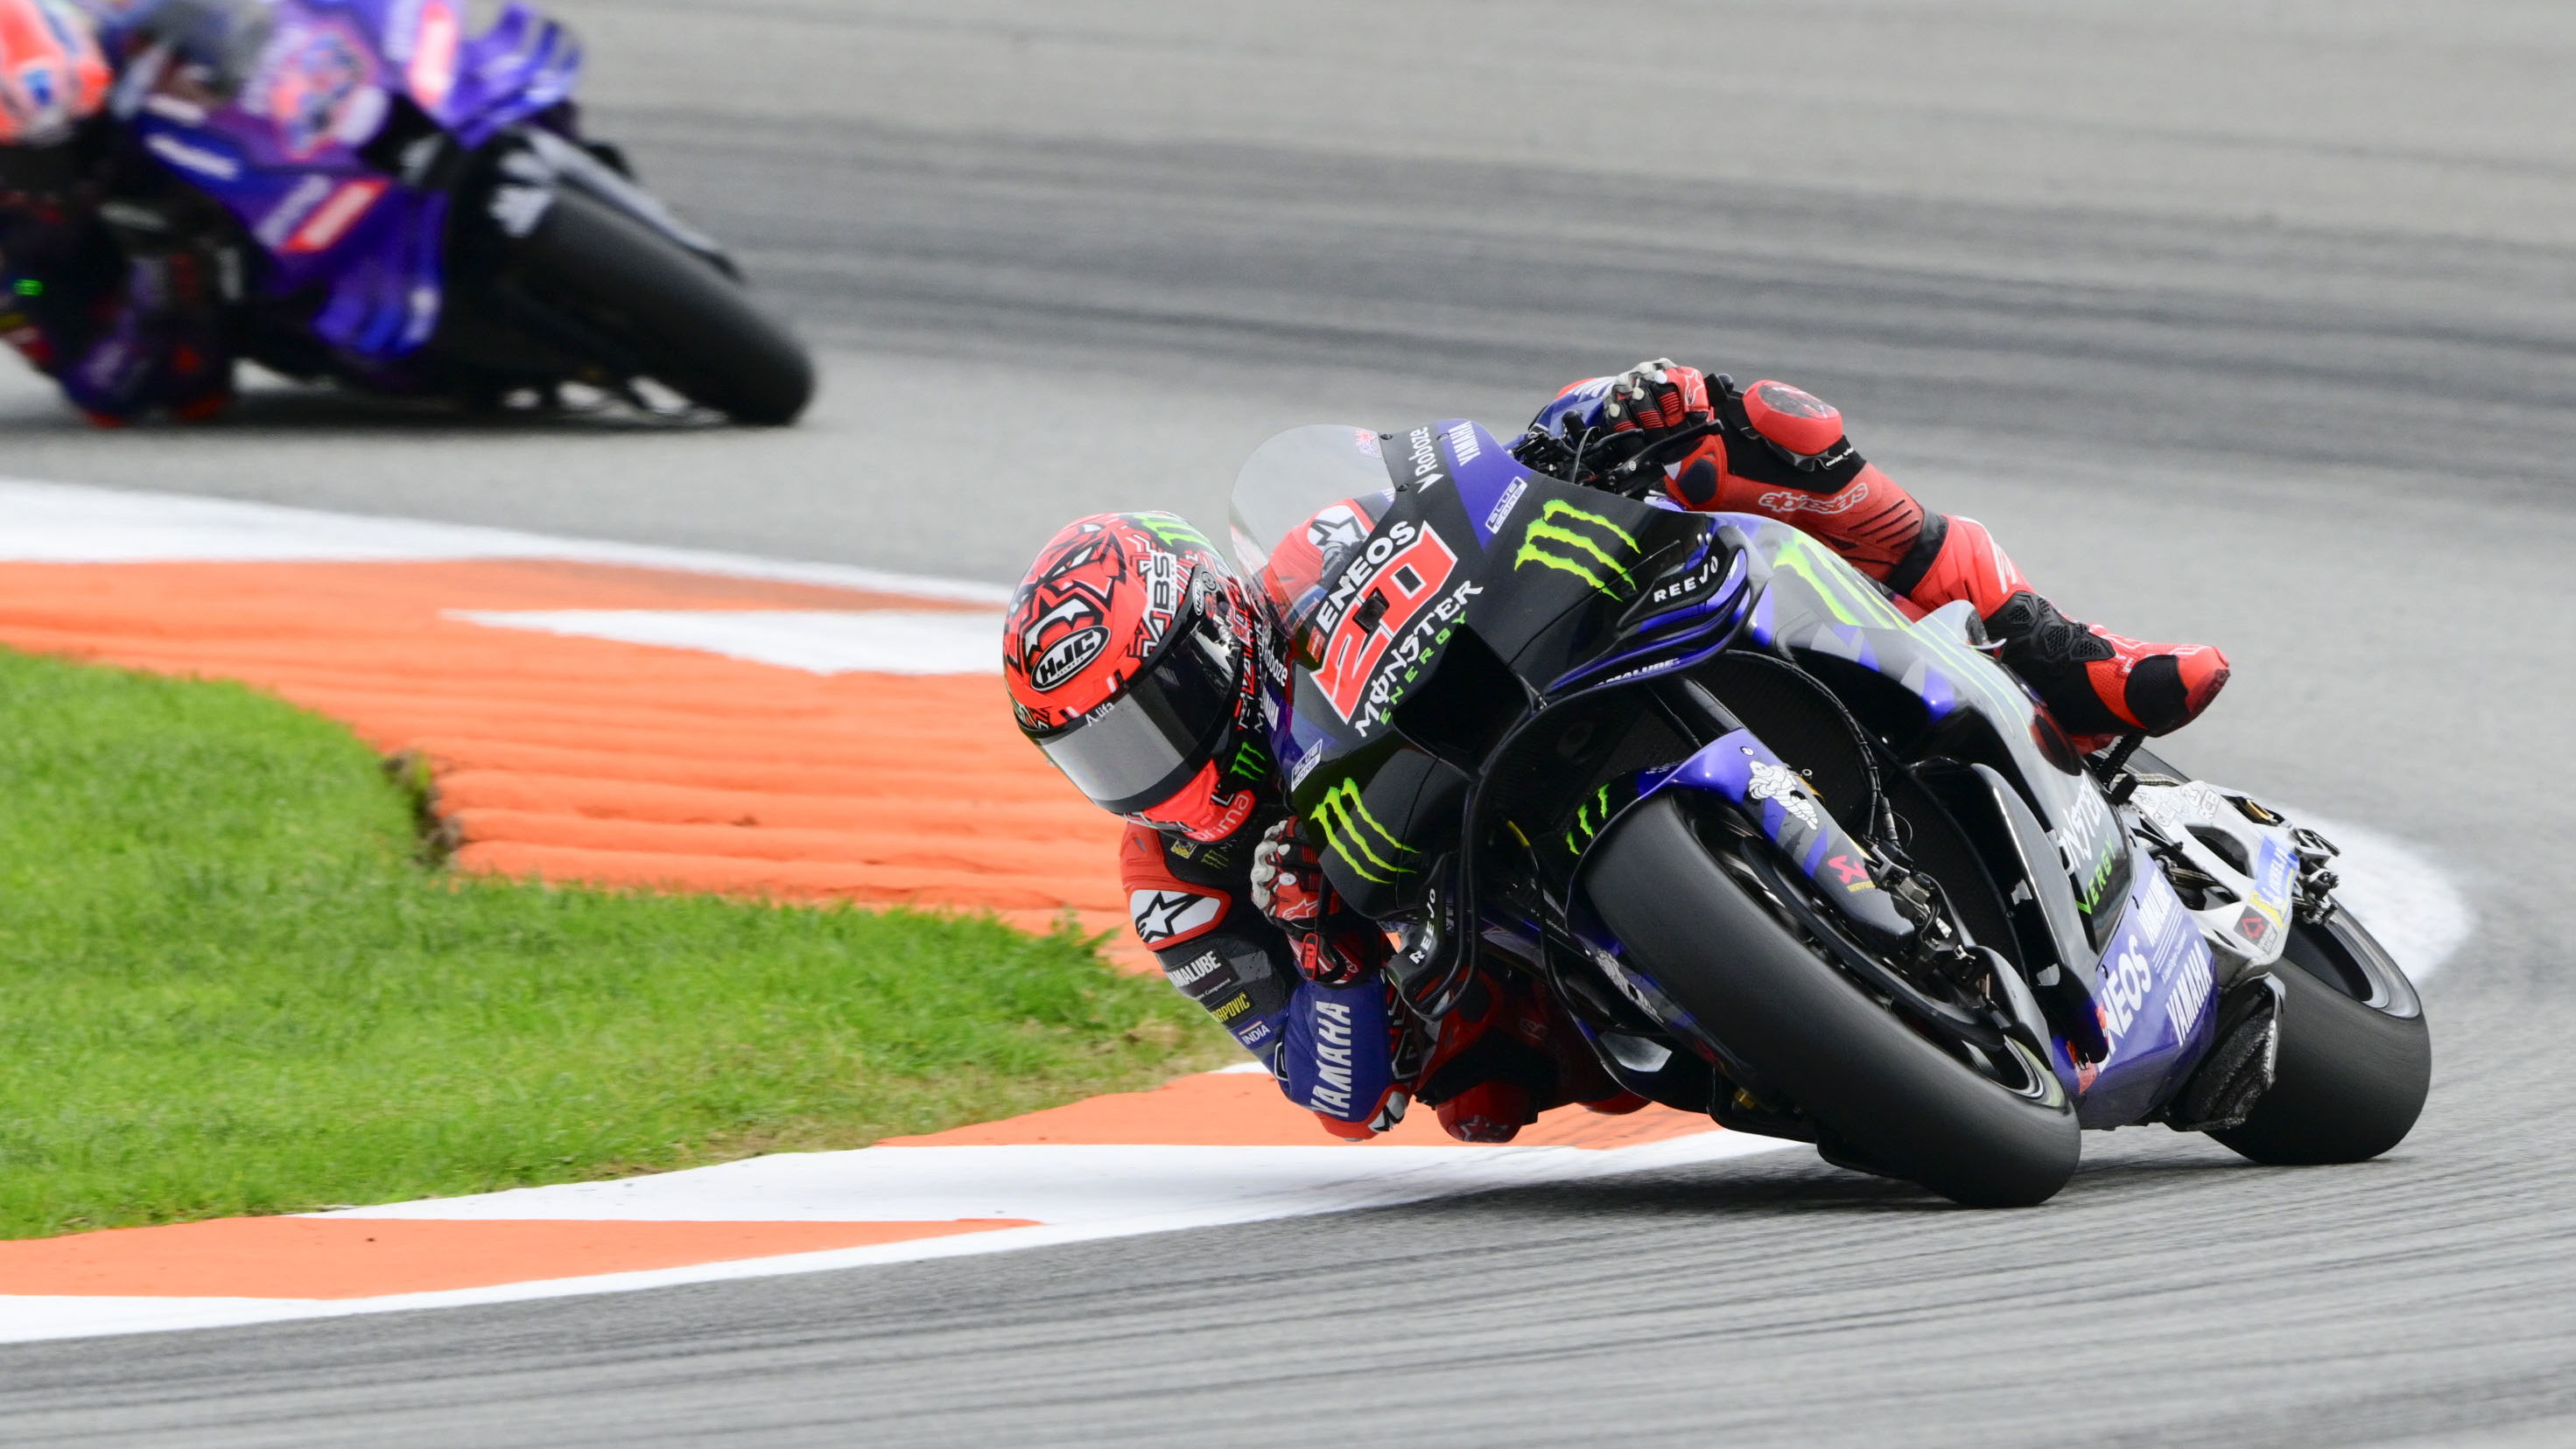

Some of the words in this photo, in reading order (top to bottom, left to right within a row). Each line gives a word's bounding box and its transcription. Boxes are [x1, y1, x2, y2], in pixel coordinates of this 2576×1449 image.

[1408, 426, 1437, 477] Roboze
[1448, 421, 1481, 466] YAMAHA
[1316, 521, 1416, 634] ENEOS
[1039, 630, 1096, 684] HJC
[1380, 611, 1466, 725] ENERGY
[2165, 940, 2213, 1047] YAMAHA
[1241, 1024, 1271, 1046] INDIA
[1309, 1000, 1351, 1117] YAMAHA
